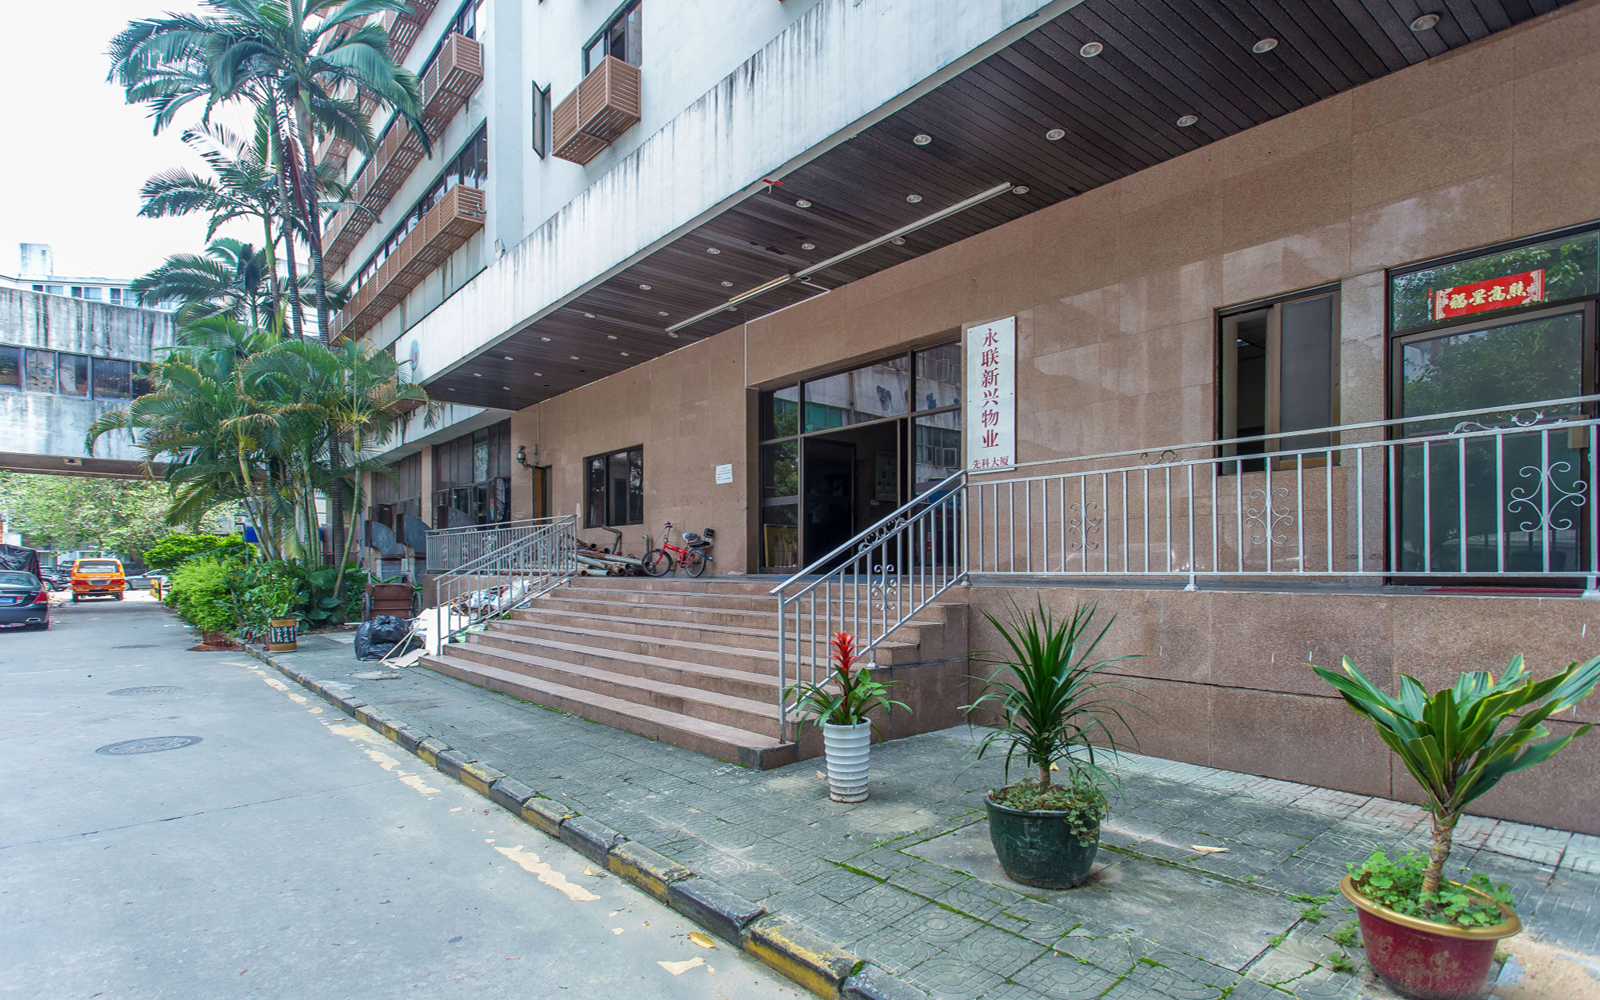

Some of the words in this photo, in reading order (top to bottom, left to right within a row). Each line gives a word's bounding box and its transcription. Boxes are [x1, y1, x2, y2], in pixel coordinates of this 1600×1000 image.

[980, 328, 1000, 449] 永联新兴物业
[972, 456, 1009, 469] 先科大厦
